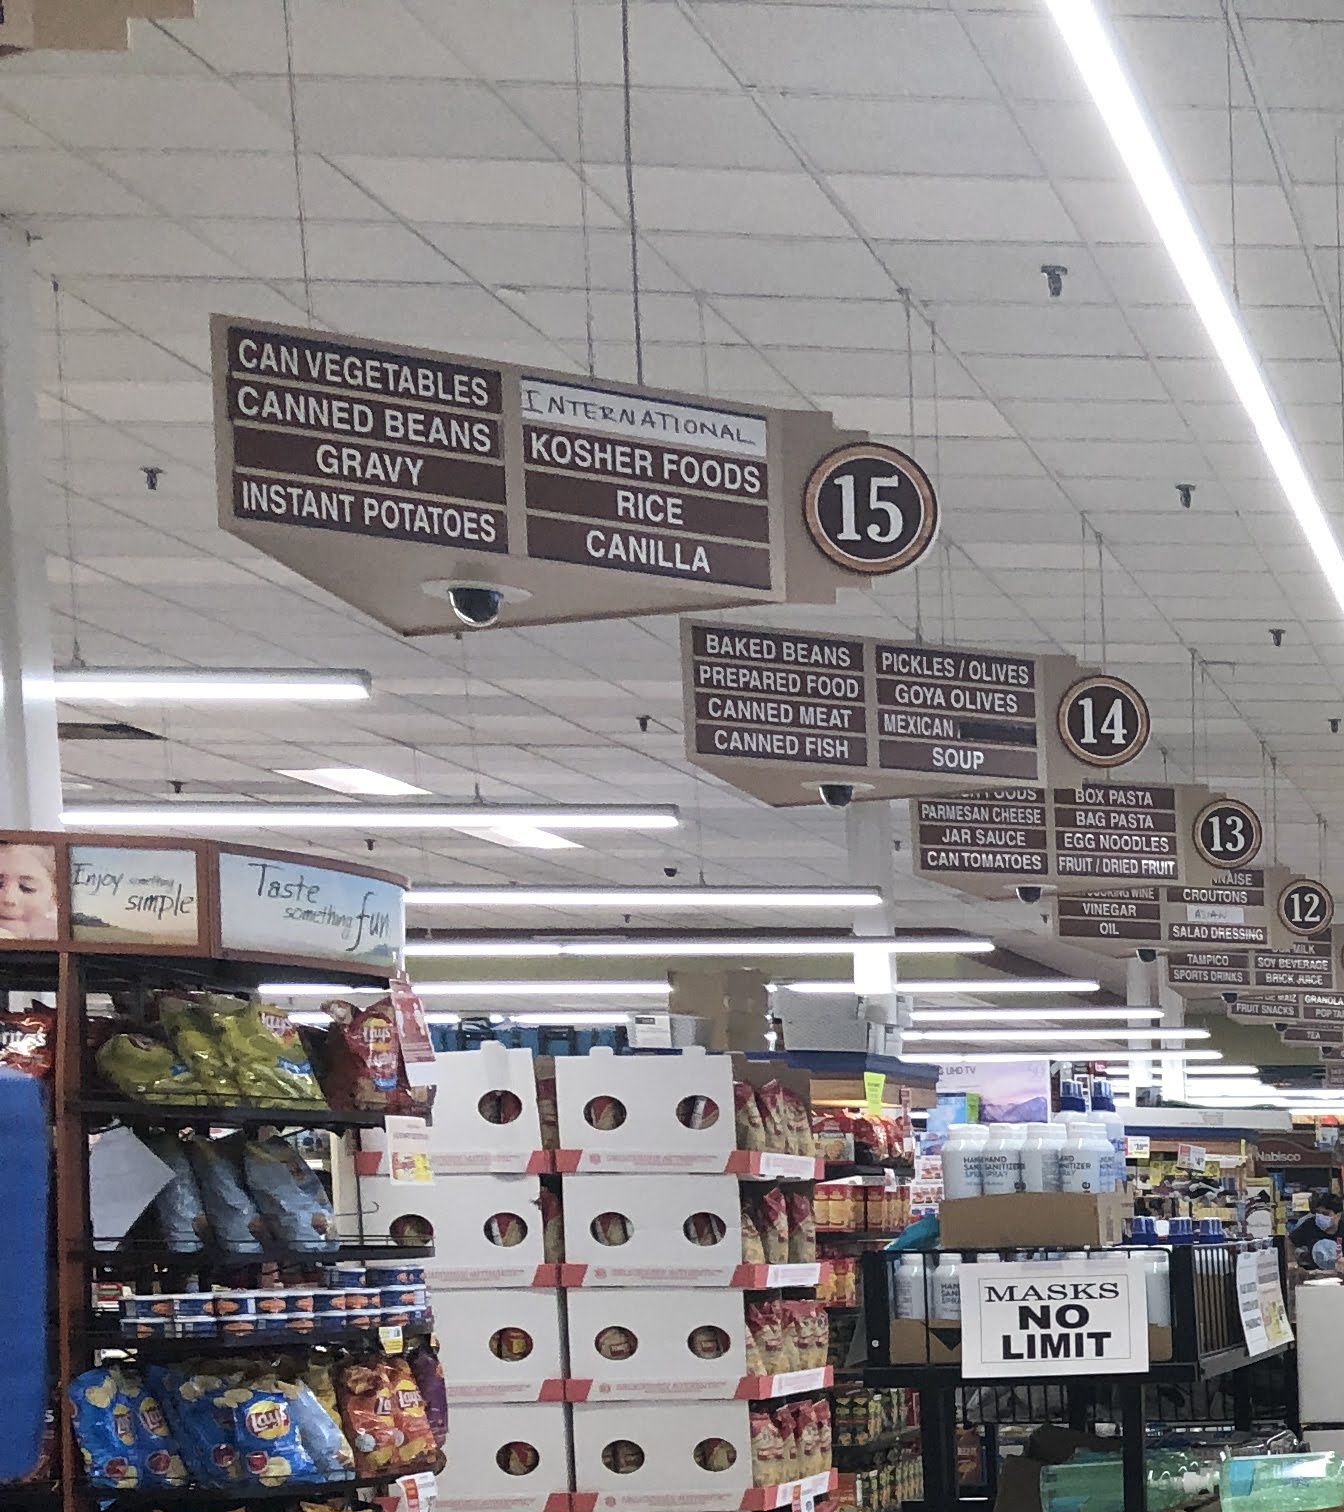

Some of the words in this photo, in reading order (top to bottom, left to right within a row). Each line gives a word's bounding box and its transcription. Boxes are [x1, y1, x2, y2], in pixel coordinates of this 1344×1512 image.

[238, 337, 299, 377] CAN
[304, 349, 489, 406] VEGETABLES
[237, 384, 374, 434] CANNED
[383, 408, 492, 455] BEANS
[525, 387, 756, 447] INTERNATIONAL
[315, 443, 424, 487] GRAVY
[530, 432, 653, 479] KOSHER
[661, 450, 762, 494] FOODS
[241, 479, 354, 526] INSTANT
[363, 495, 497, 544] POTATOES
[616, 490, 684, 527] RICE
[833, 474, 904, 542] 15
[585, 531, 712, 574] CANILLA
[705, 633, 776, 662] BAKED
[782, 641, 851, 667] BEANS
[699, 665, 801, 695] PREPARED
[806, 673, 860, 699] FOOD
[881, 651, 956, 678] PICKLES
[968, 660, 1030, 686] OLIVES
[707, 697, 794, 725] CANNED
[798, 705, 853, 730] MEAT
[894, 683, 946, 708] GOYA
[950, 688, 1019, 714] OLIVES
[883, 713, 954, 738] MEXICAN
[1077, 696, 1128, 746] 14
[714, 729, 800, 756] CANNED
[804, 735, 849, 760] FISH
[931, 747, 985, 771] SOUP
[1075, 788, 1105, 804] BOX
[1108, 790, 1154, 807] PASTA
[921, 804, 991, 822] PARMESAN
[992, 807, 1042, 824] CHEESE
[1075, 812, 1106, 829] BAG
[1109, 813, 1155, 830] PASTA
[941, 828, 974, 845] JAR
[975, 830, 1027, 847] SAUCE
[1063, 833, 1098, 850] EGG
[1098, 836, 1170, 853] NOODLES
[1207, 815, 1246, 853] 13
[927, 851, 960, 868] CAN
[963, 853, 1043, 871] TOMATOES
[1058, 856, 1093, 873] FRUIT
[1103, 858, 1139, 875] DRIED
[1141, 859, 1176, 876] FRUIT
[72, 862, 124, 896] Enjoy
[248, 862, 321, 905] Taste
[125, 884, 194, 921] simple
[1082, 902, 1137, 918] VINEGAR
[1182, 889, 1249, 904] CROUTONS
[1289, 892, 1322, 923] 12
[283, 904, 355, 939] something
[344, 891, 392, 952] fun
[1099, 921, 1120, 936] OIL
[1172, 925, 1208, 940] SALAD
[1210, 926, 1264, 942] DRESSING
[1186, 953, 1230, 967] TAMPICO
[1257, 957, 1277, 969] SOY
[1278, 957, 1329, 971] BEVERAGE
[1173, 968, 1209, 982] SPORTS
[1210, 969, 1244, 984] DRINKS
[1257, 1149, 1301, 1164] Nabisco
[984, 1282, 1120, 1303] MASKS
[1018, 1303, 1091, 1331] NO
[1002, 1331, 1112, 1360] LIMIT
